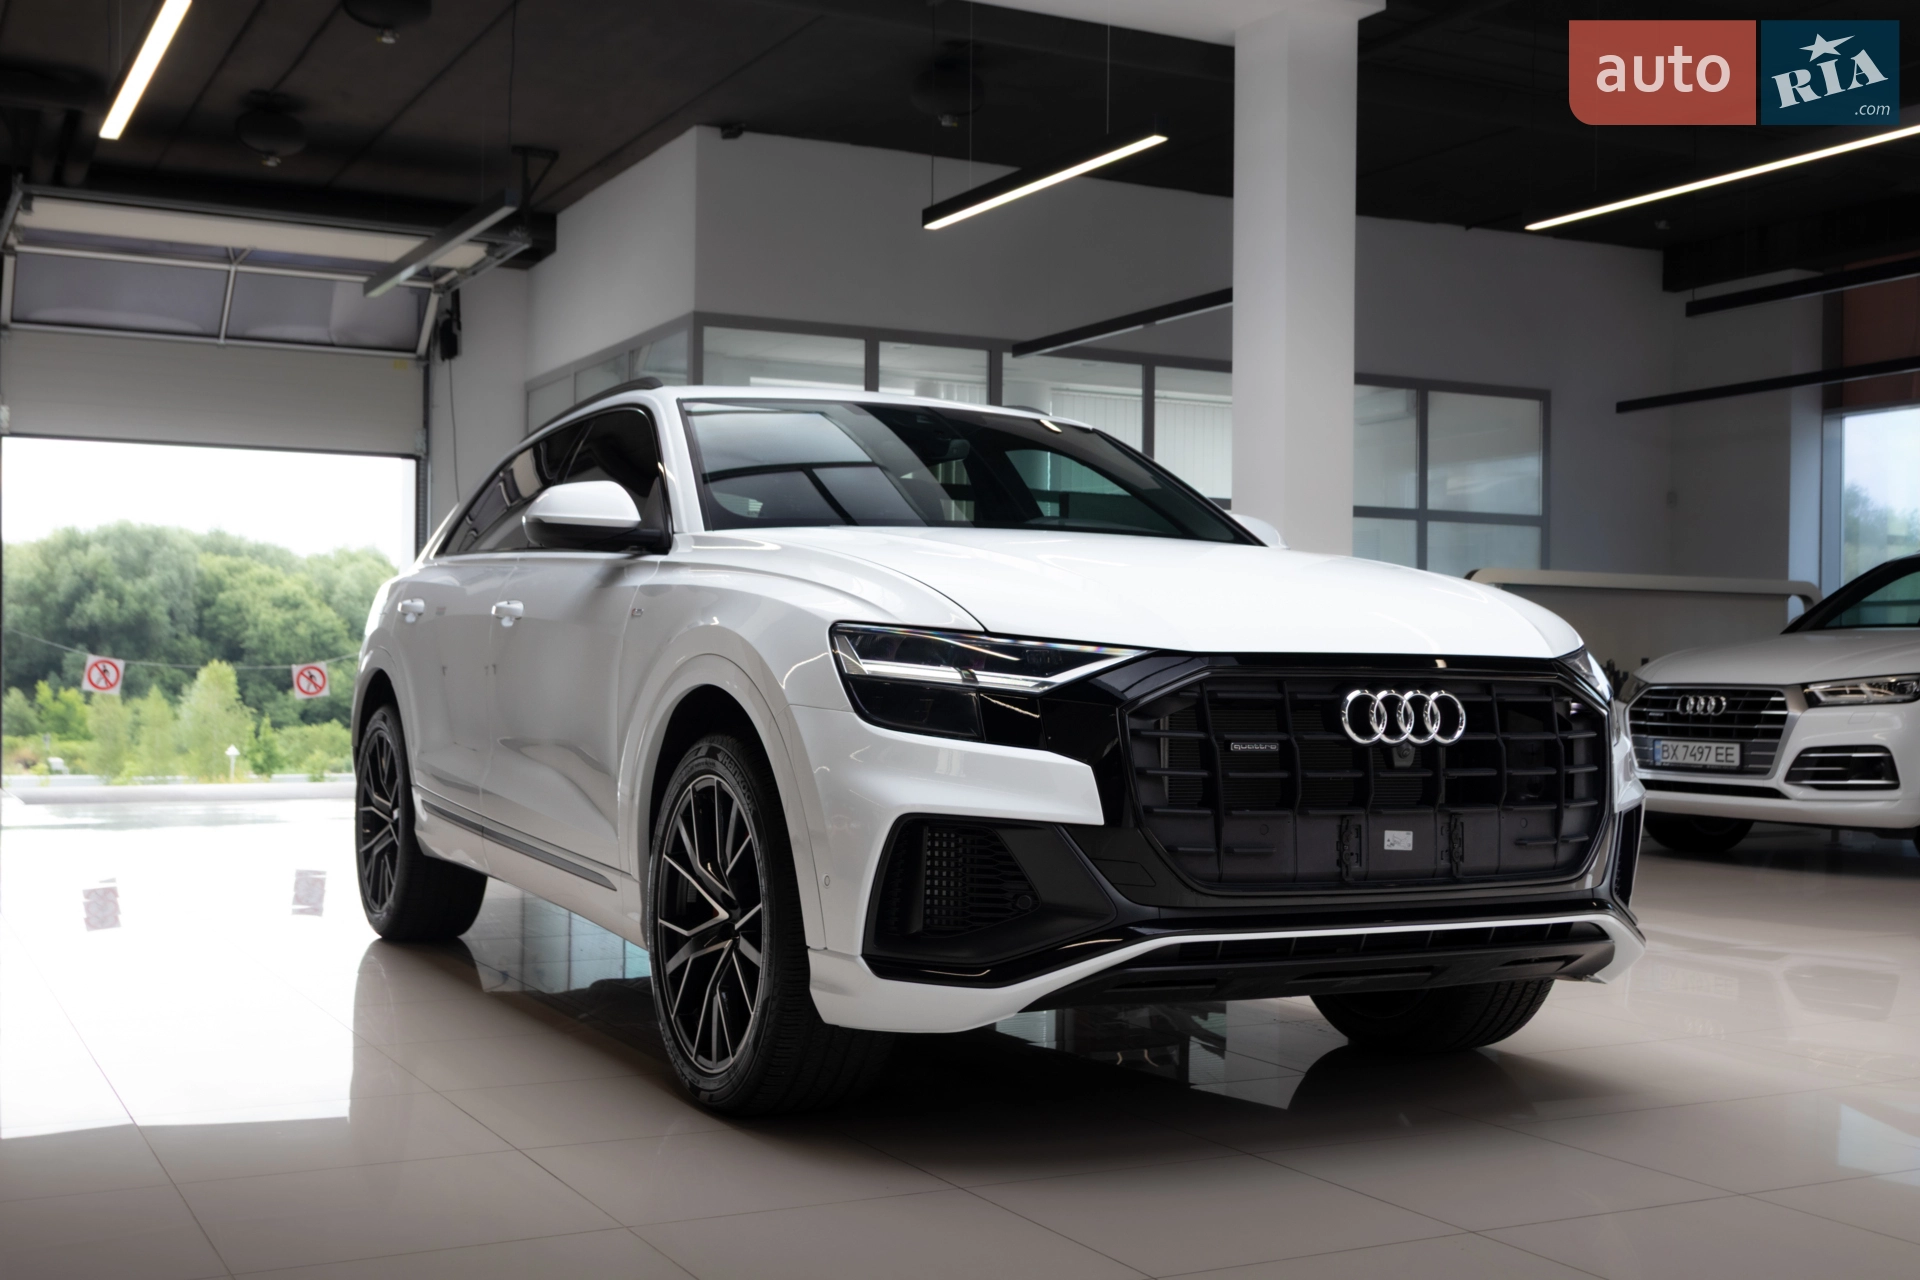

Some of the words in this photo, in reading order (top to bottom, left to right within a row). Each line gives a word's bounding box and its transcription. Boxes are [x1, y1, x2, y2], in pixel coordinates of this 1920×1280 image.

[1232, 743, 1277, 751] quattro
[1661, 744, 1679, 761] BX
[1682, 745, 1712, 762] 7497
[1715, 746, 1735, 763] EE
